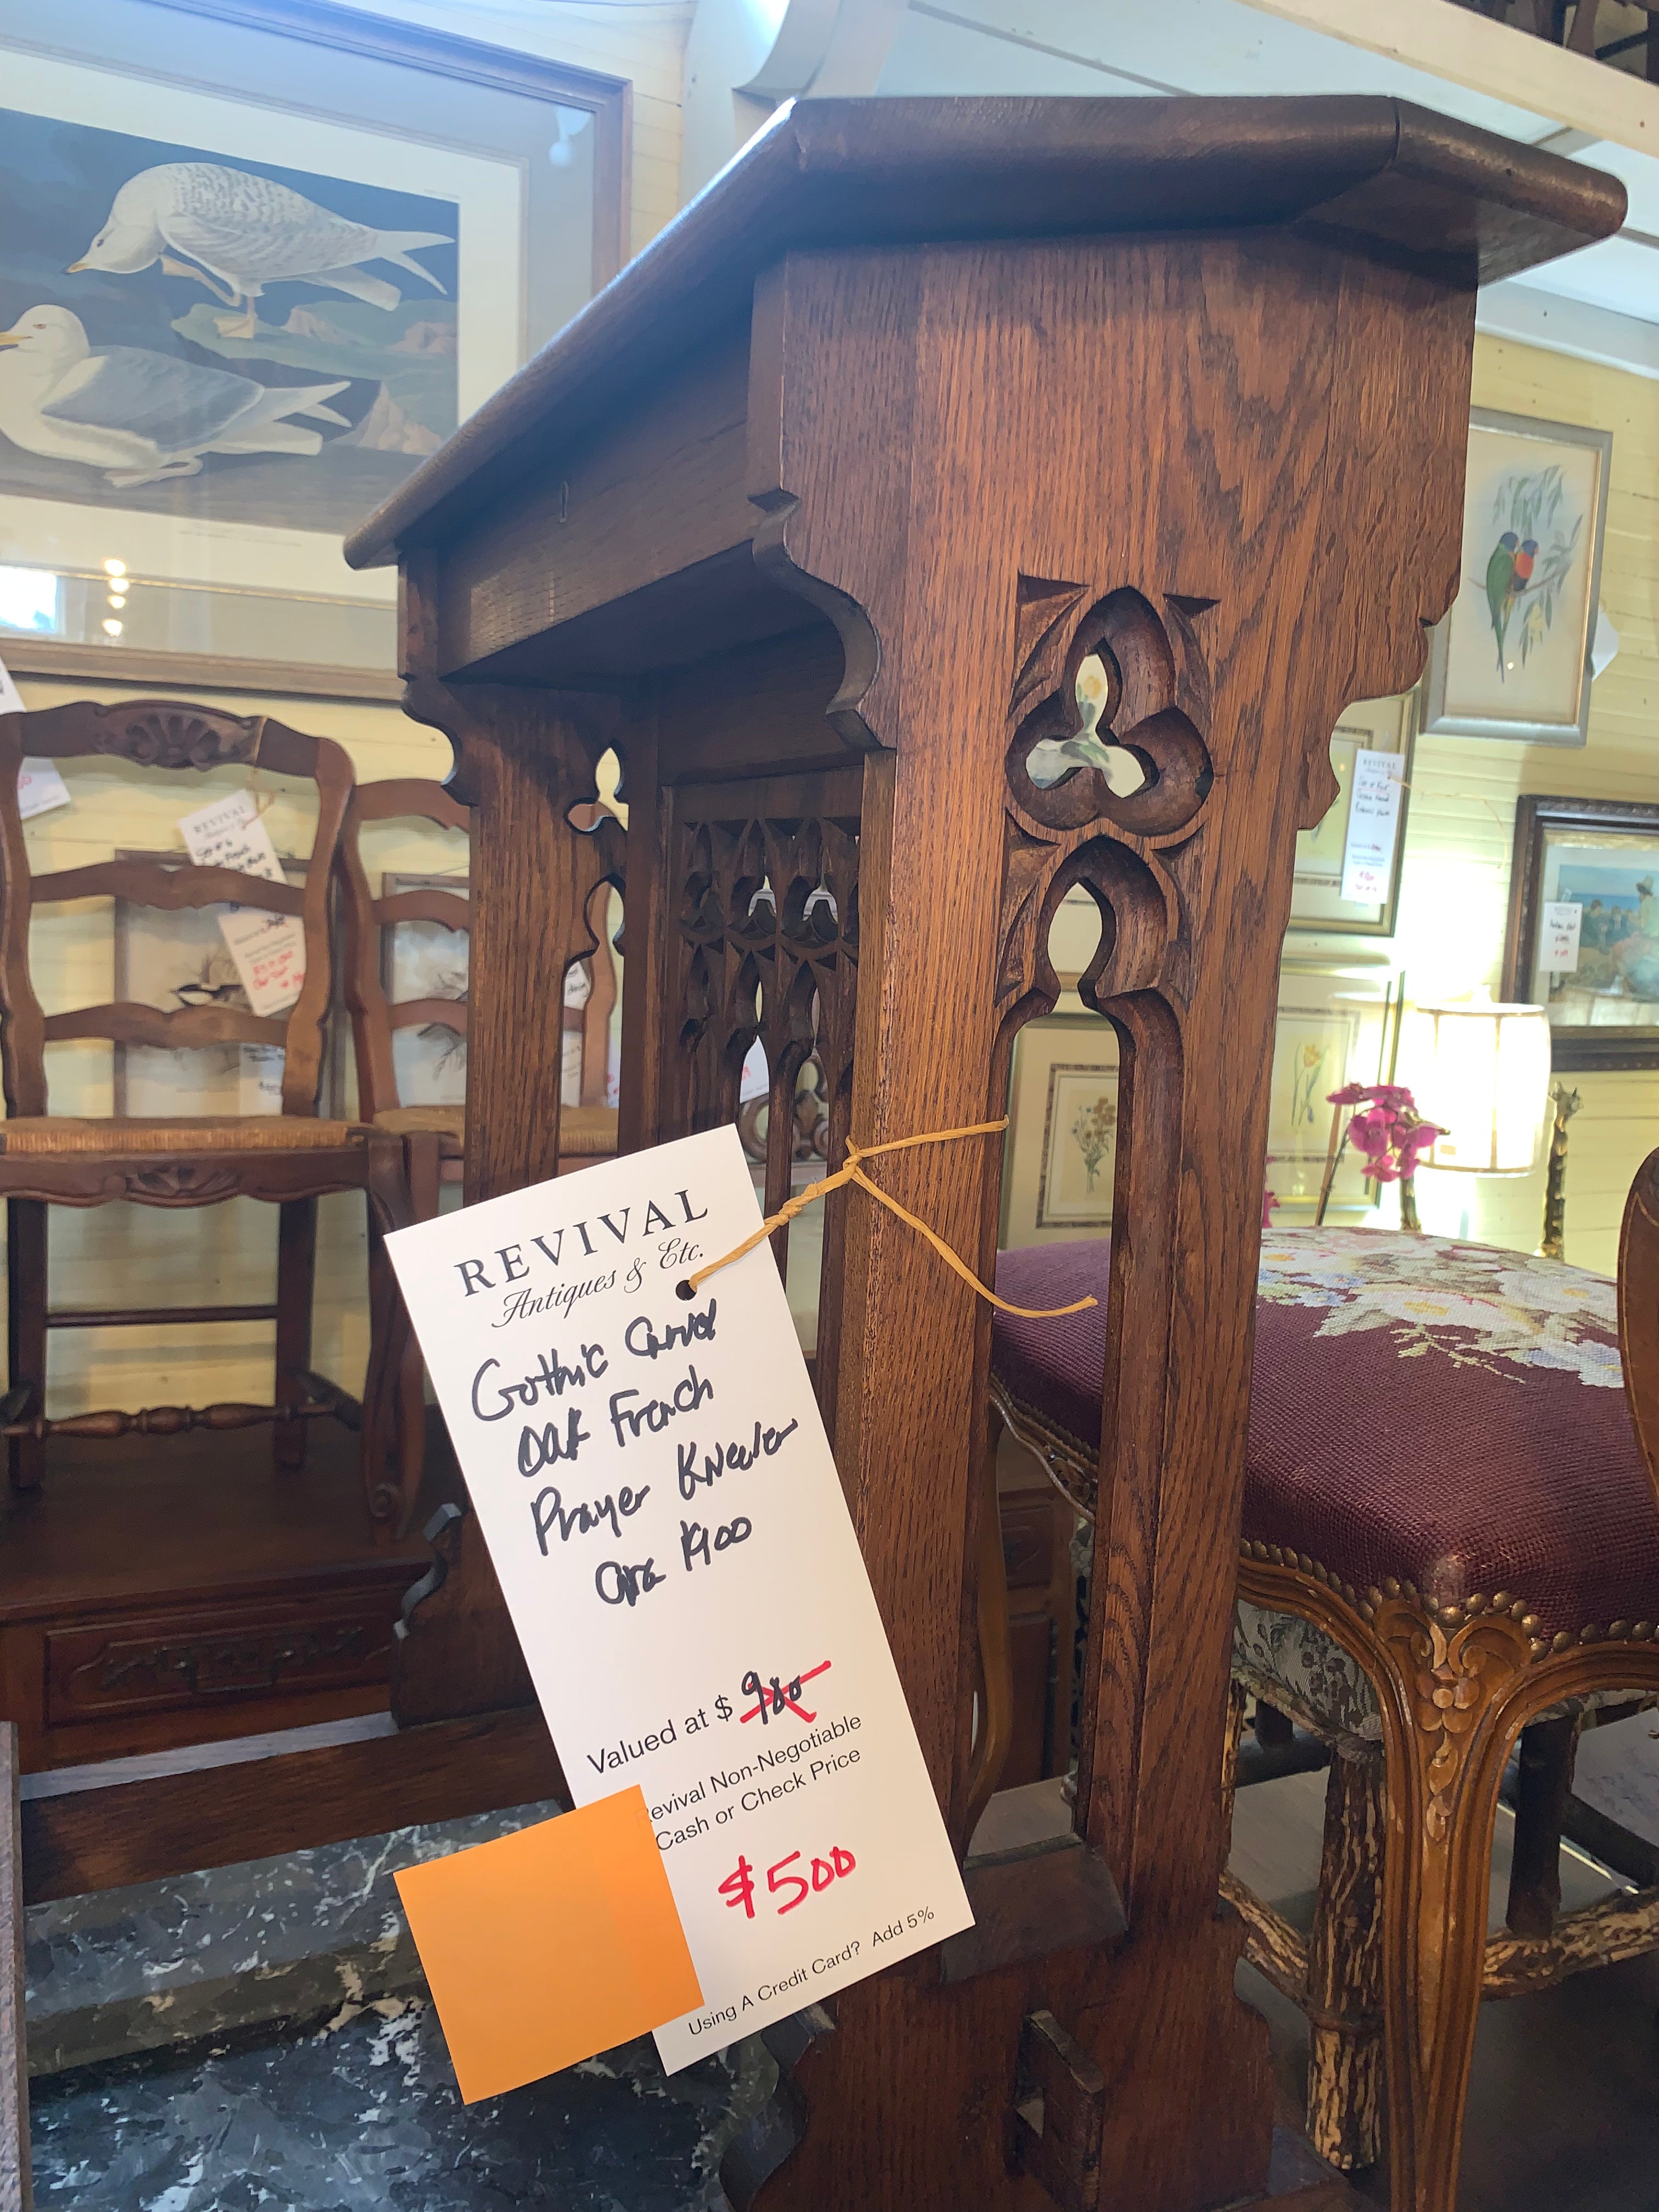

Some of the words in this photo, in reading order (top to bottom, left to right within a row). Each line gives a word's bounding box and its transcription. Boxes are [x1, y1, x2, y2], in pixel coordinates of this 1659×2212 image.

[455, 1189, 708, 1297] REVIVAL
[491, 1272, 616, 1328] Antiques
[624, 1259, 646, 1293] &
[658, 1238, 704, 1269] Etc.
[472, 1344, 608, 1421] Gothic
[518, 1408, 591, 1477] Oak
[610, 1365, 714, 1447] French
[531, 1485, 651, 1556] Prayer
[587, 1725, 677, 1775] Valued
[685, 1709, 709, 1735] at
[715, 1695, 733, 1722] $
[648, 1782, 706, 1821] evival
[710, 1714, 862, 1793] Non-Negotiable
[656, 1817, 709, 1850] Cash
[716, 1807, 735, 1826] or
[741, 1775, 806, 1811] Check
[809, 1748, 861, 1780] Price
[718, 1846, 856, 1918] $500
[689, 2005, 737, 2036] Using
[742, 1995, 754, 2011] A
[758, 1968, 808, 2002] Credit
[811, 1941, 860, 1974] Card?
[872, 1920, 903, 1947] Add
[907, 1906, 935, 1928] 5%
